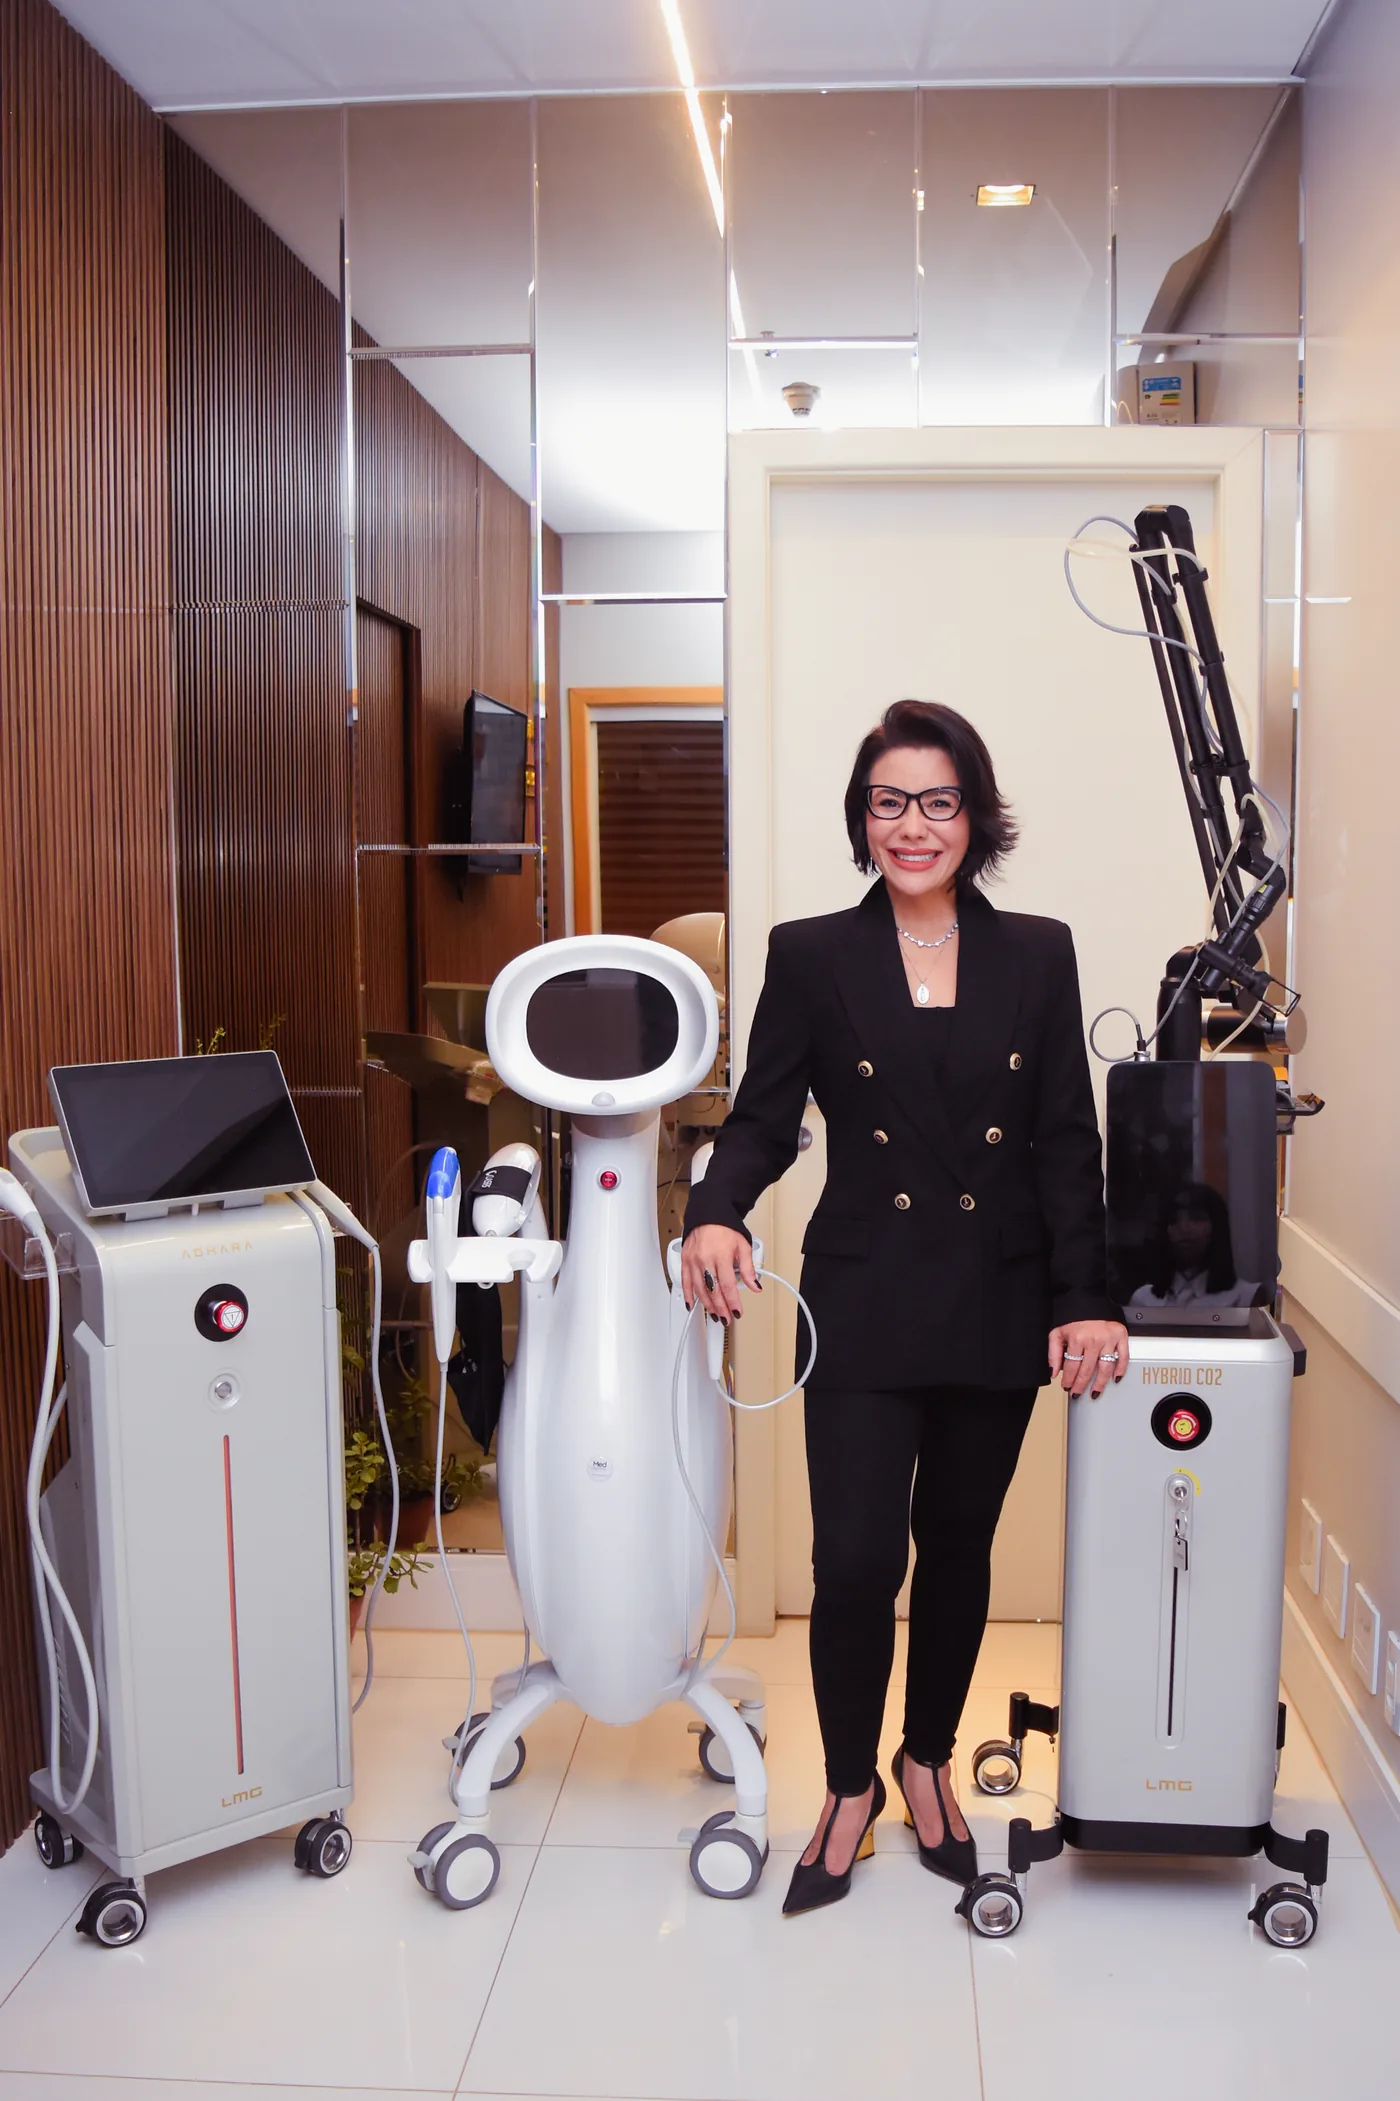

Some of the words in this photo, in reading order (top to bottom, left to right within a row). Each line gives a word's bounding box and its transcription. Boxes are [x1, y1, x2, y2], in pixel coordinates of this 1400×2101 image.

[1142, 1366, 1191, 1385] HYBRID
[1196, 1367, 1223, 1386] CO2
[1146, 1778, 1192, 1791] LMG
[222, 1786, 262, 1808] LMG
